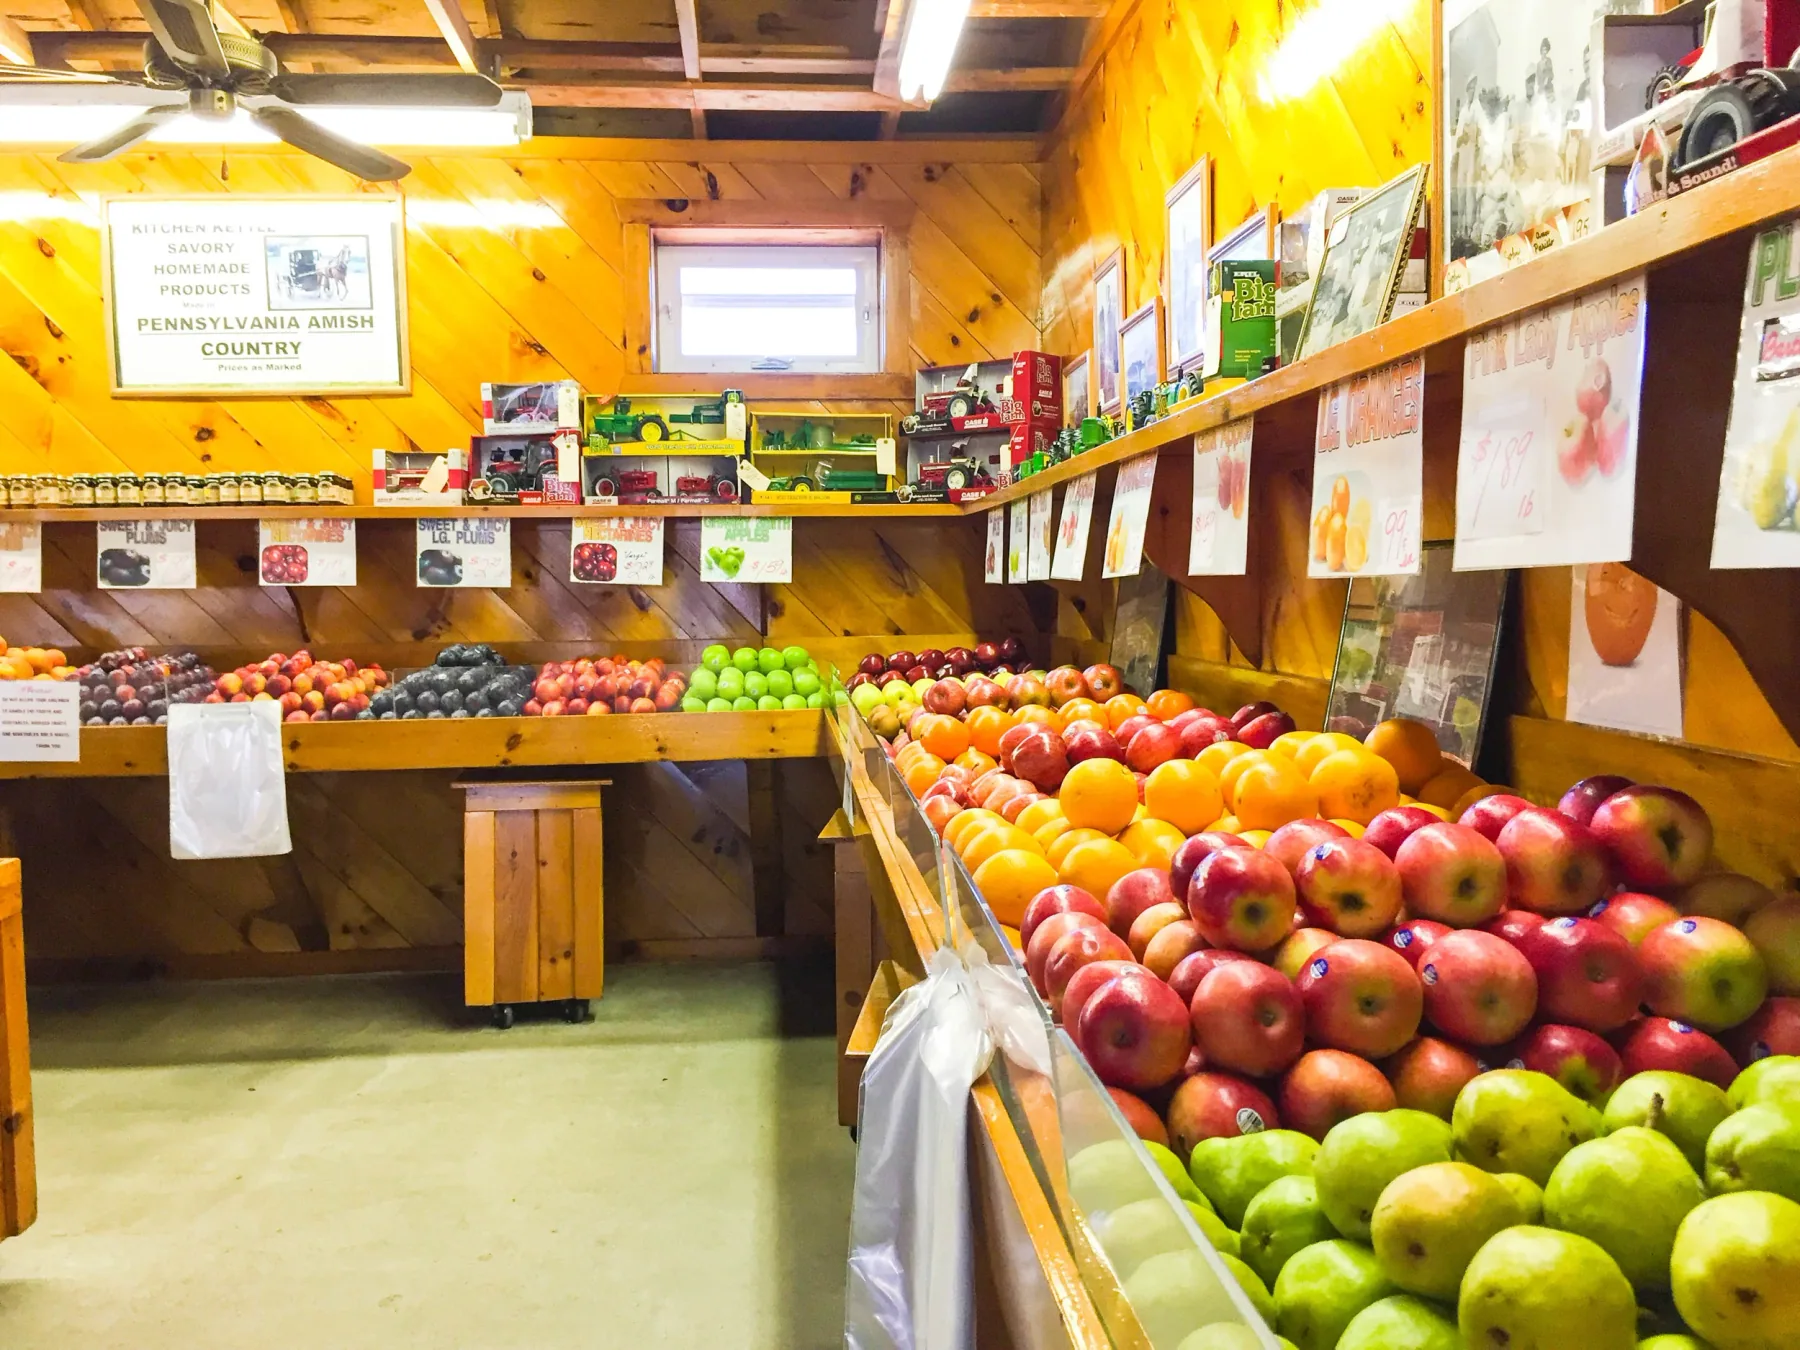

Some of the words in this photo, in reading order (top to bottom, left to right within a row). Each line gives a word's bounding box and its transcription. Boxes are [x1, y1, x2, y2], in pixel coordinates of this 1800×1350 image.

[1680, 155, 1738, 190] Sound!
[132, 224, 205, 234] KITCHEN
[168, 243, 235, 254] SAVORY
[154, 263, 250, 275] HOMEMADE
[160, 283, 251, 296] PRODUCTS
[1233, 277, 1275, 303] Big
[137, 316, 300, 332] PENNSYLVANIA
[307, 315, 375, 329] AMISH
[1468, 331, 1508, 379] Pink
[1512, 308, 1562, 370] Lady
[1567, 284, 1640, 359] Apples
[201, 341, 302, 357] COUNTRY
[218, 364, 248, 373] Prices
[266, 363, 302, 372] Marked
[1001, 401, 1023, 413] Big
[1346, 359, 1421, 449] ORANGES
[964, 419, 982, 427] CASE
[1001, 411, 1025, 424] farm
[418, 518, 458, 531] SWEET
[463, 518, 470, 531] &
[476, 518, 508, 532] JUICY
[126, 532, 168, 544] PLUMS
[432, 531, 451, 544] LG.
[456, 531, 495, 545] PLUMS
[724, 529, 770, 542] APPLES
